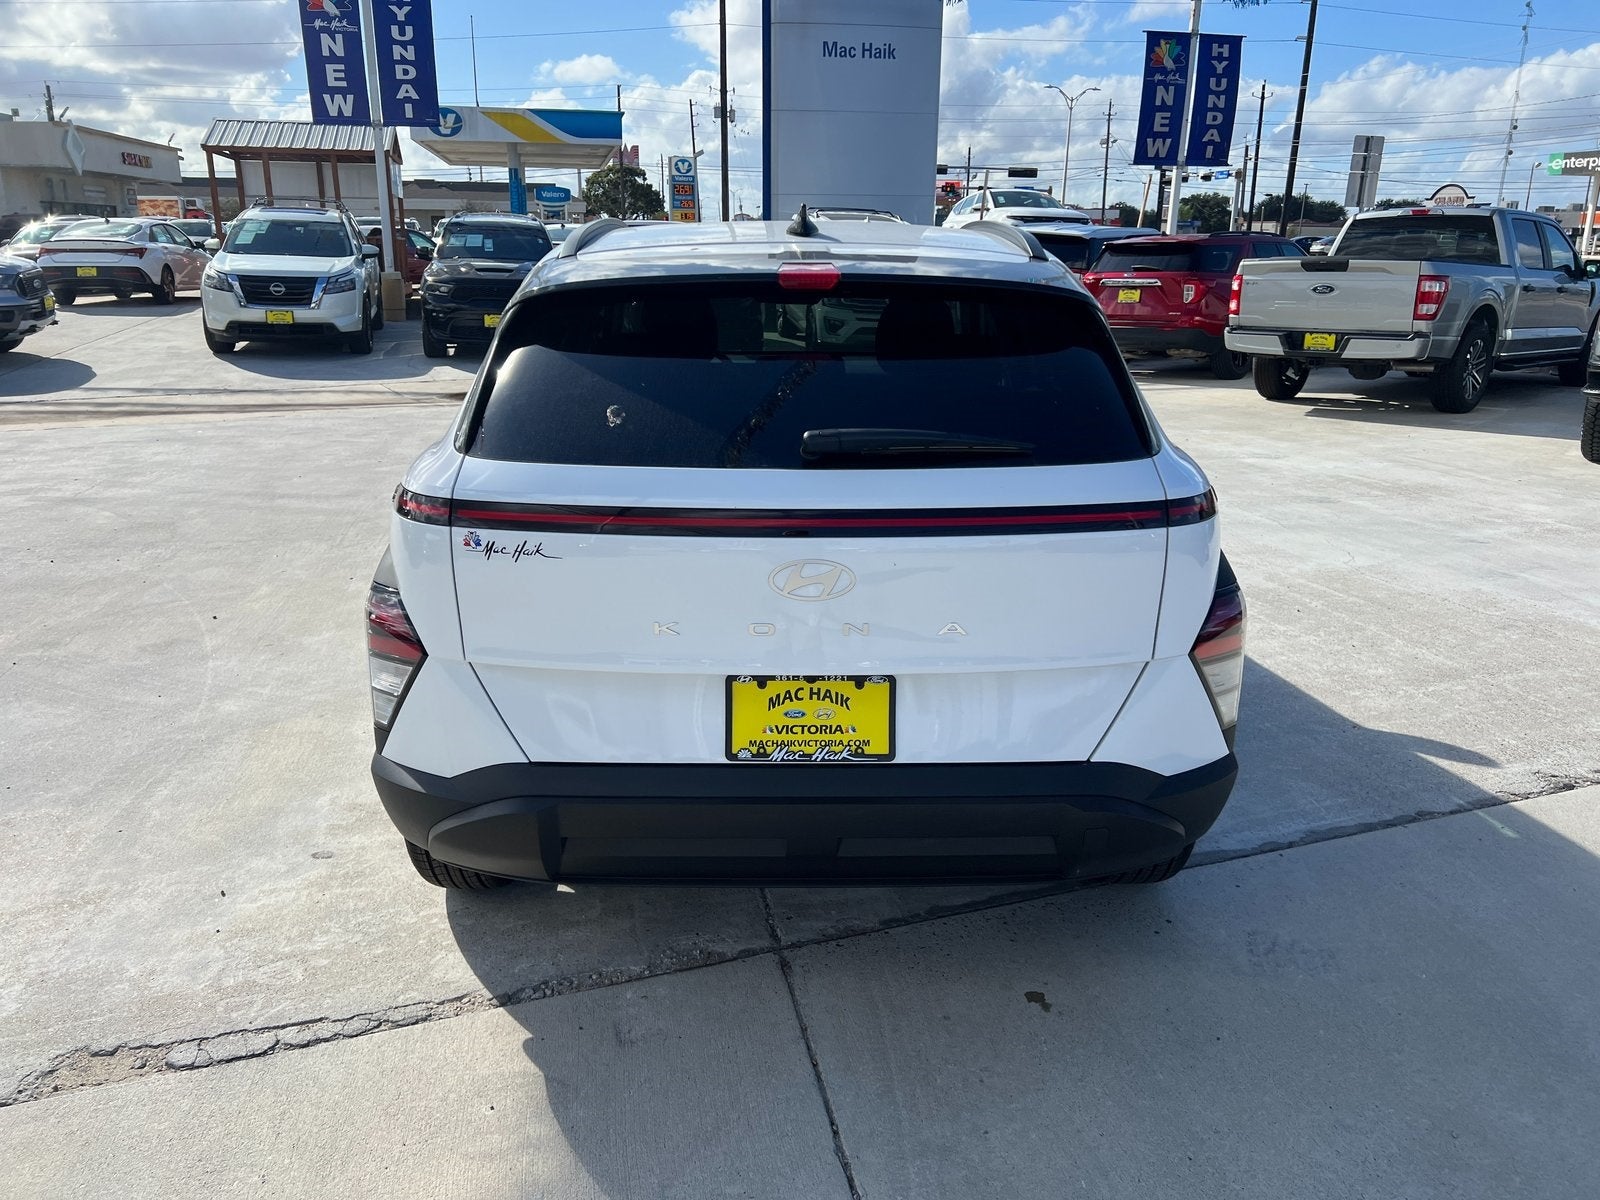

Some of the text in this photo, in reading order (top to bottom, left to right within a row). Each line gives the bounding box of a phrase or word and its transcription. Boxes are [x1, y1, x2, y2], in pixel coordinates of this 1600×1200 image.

[823, 41, 896, 59] Mac Haik
[320, 33, 354, 117] NEW
[1202, 43, 1230, 158] HYUNDAI
[1146, 85, 1175, 158] NEW
[1548, 156, 1600, 170] enterp
[541, 190, 565, 198] Valero
[653, 621, 967, 637] KONA
[768, 687, 851, 712] MAC HAIK
[775, 725, 844, 734] VICTORIA
[749, 739, 870, 747] MACHAIKVICTORIA.COM
